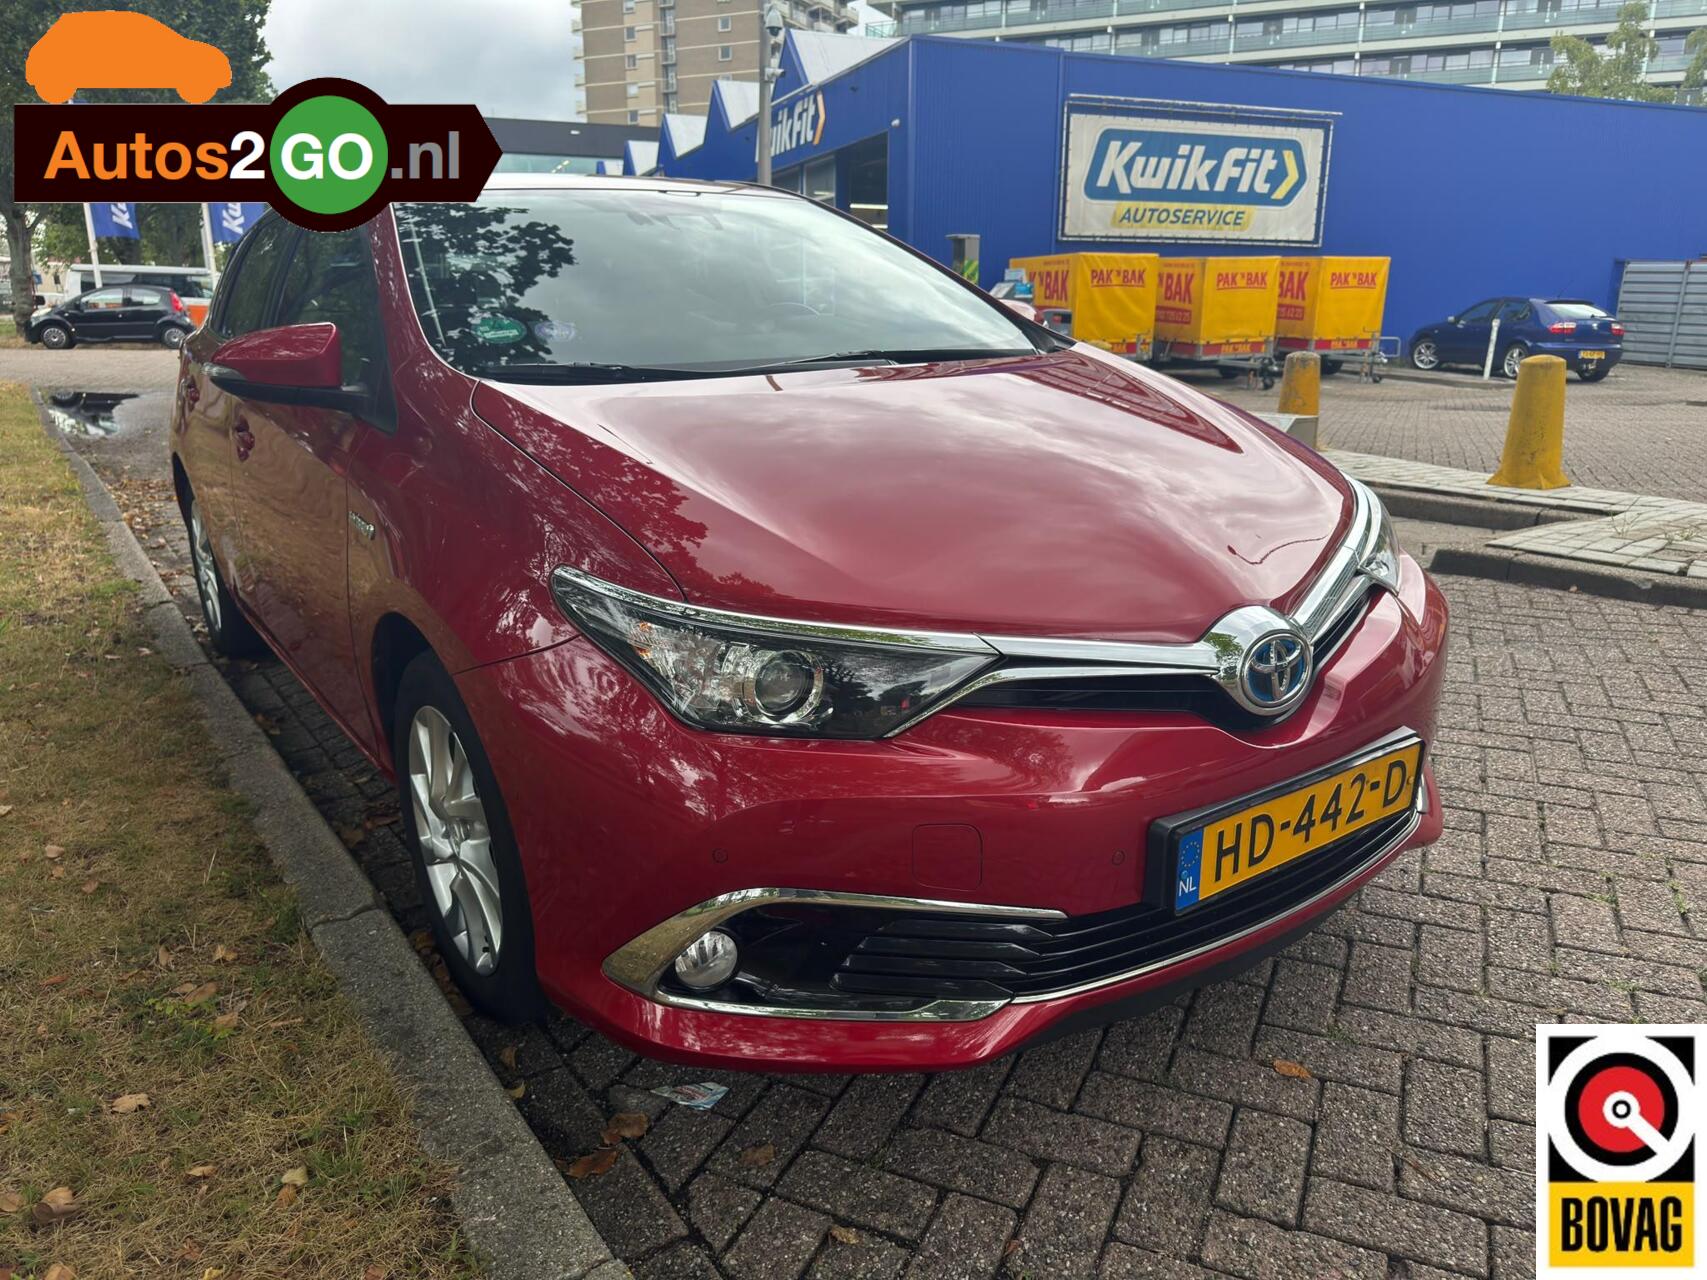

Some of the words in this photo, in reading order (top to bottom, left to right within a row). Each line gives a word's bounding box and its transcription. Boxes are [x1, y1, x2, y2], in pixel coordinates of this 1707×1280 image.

[755, 94, 816, 163] ikFit
[1119, 207, 1246, 227] AUTOSERVICE
[1044, 270, 1069, 302] BAK
[1091, 269, 1113, 284] PAK
[1122, 268, 1146, 284] BAK
[1217, 272, 1238, 288] PAK
[1246, 271, 1268, 287] BAK
[1331, 272, 1351, 287] PAK
[1357, 272, 1377, 287] BAK
[1164, 272, 1194, 304] BAK
[1214, 759, 1407, 883] HD-442-D
[1178, 875, 1197, 897] NL
